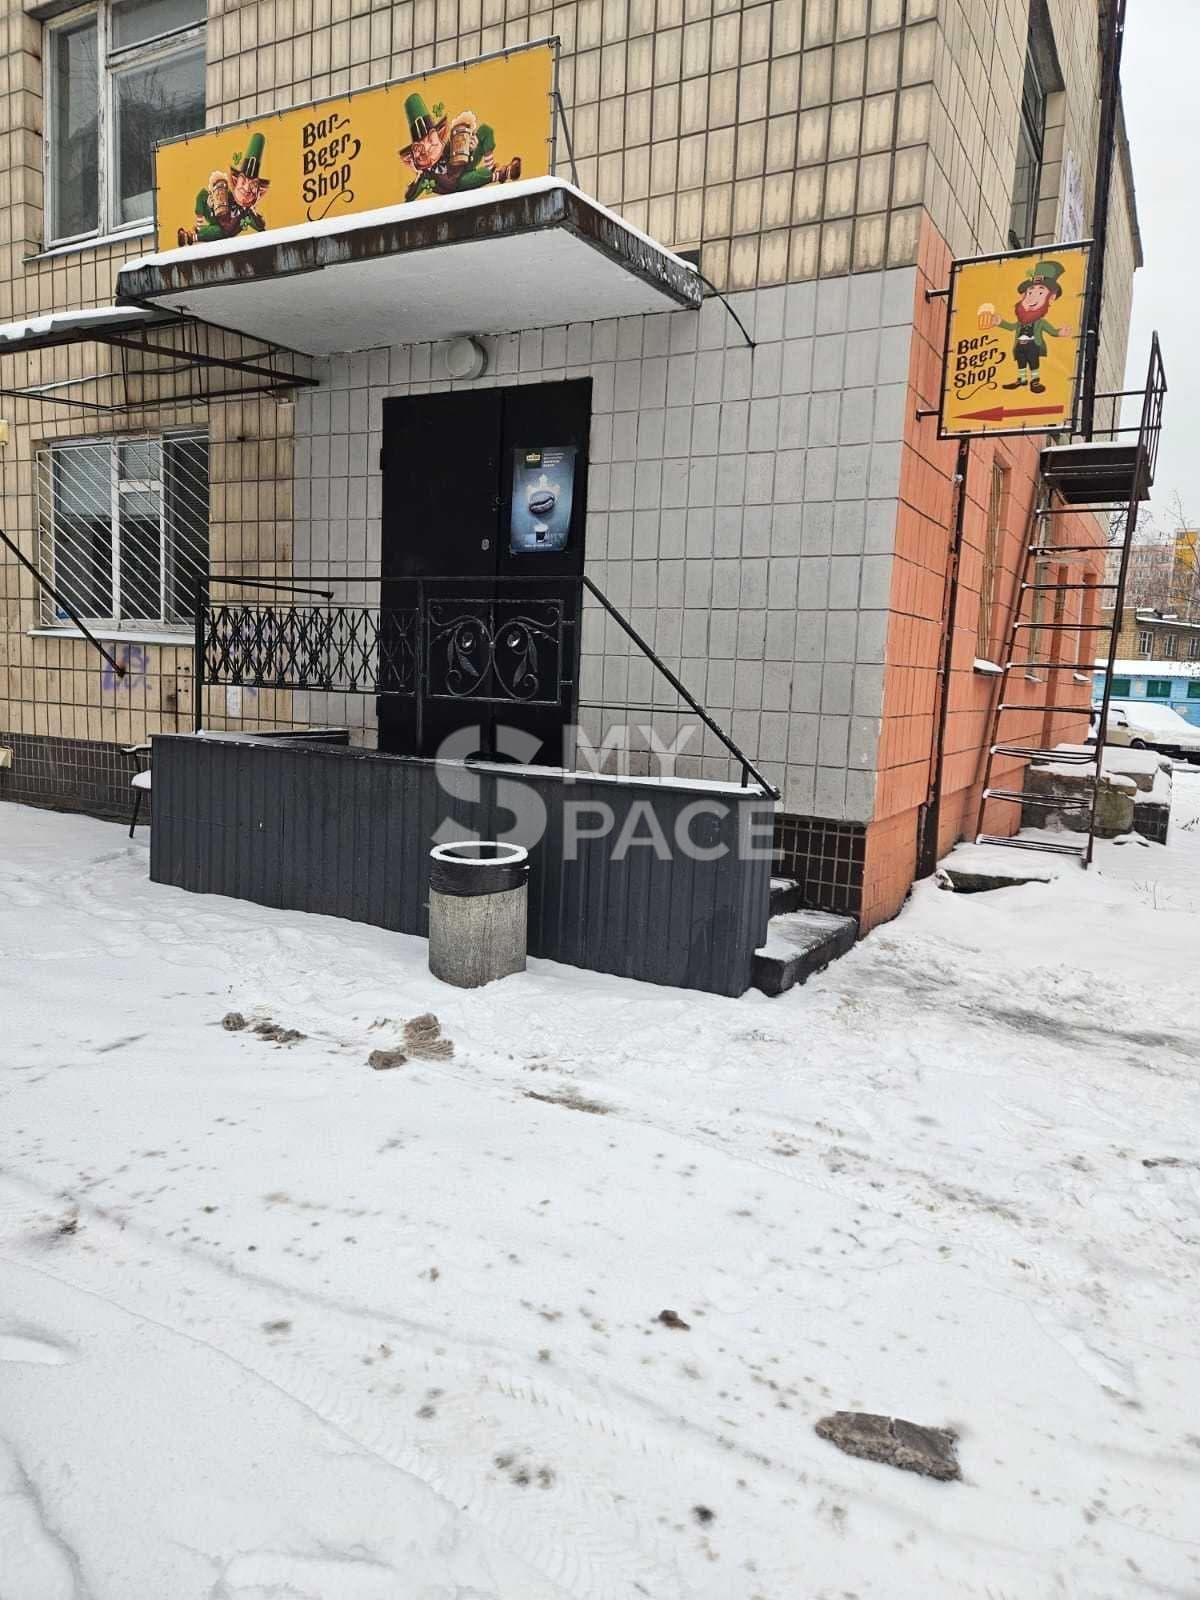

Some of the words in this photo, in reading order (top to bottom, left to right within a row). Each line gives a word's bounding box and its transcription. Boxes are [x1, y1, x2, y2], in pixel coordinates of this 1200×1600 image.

[303, 113, 350, 149] Bar
[303, 133, 361, 176] Beer
[302, 164, 354, 222] Shop
[956, 348, 1006, 371] Beer
[957, 334, 999, 355] Bar
[953, 366, 997, 400] Shop
